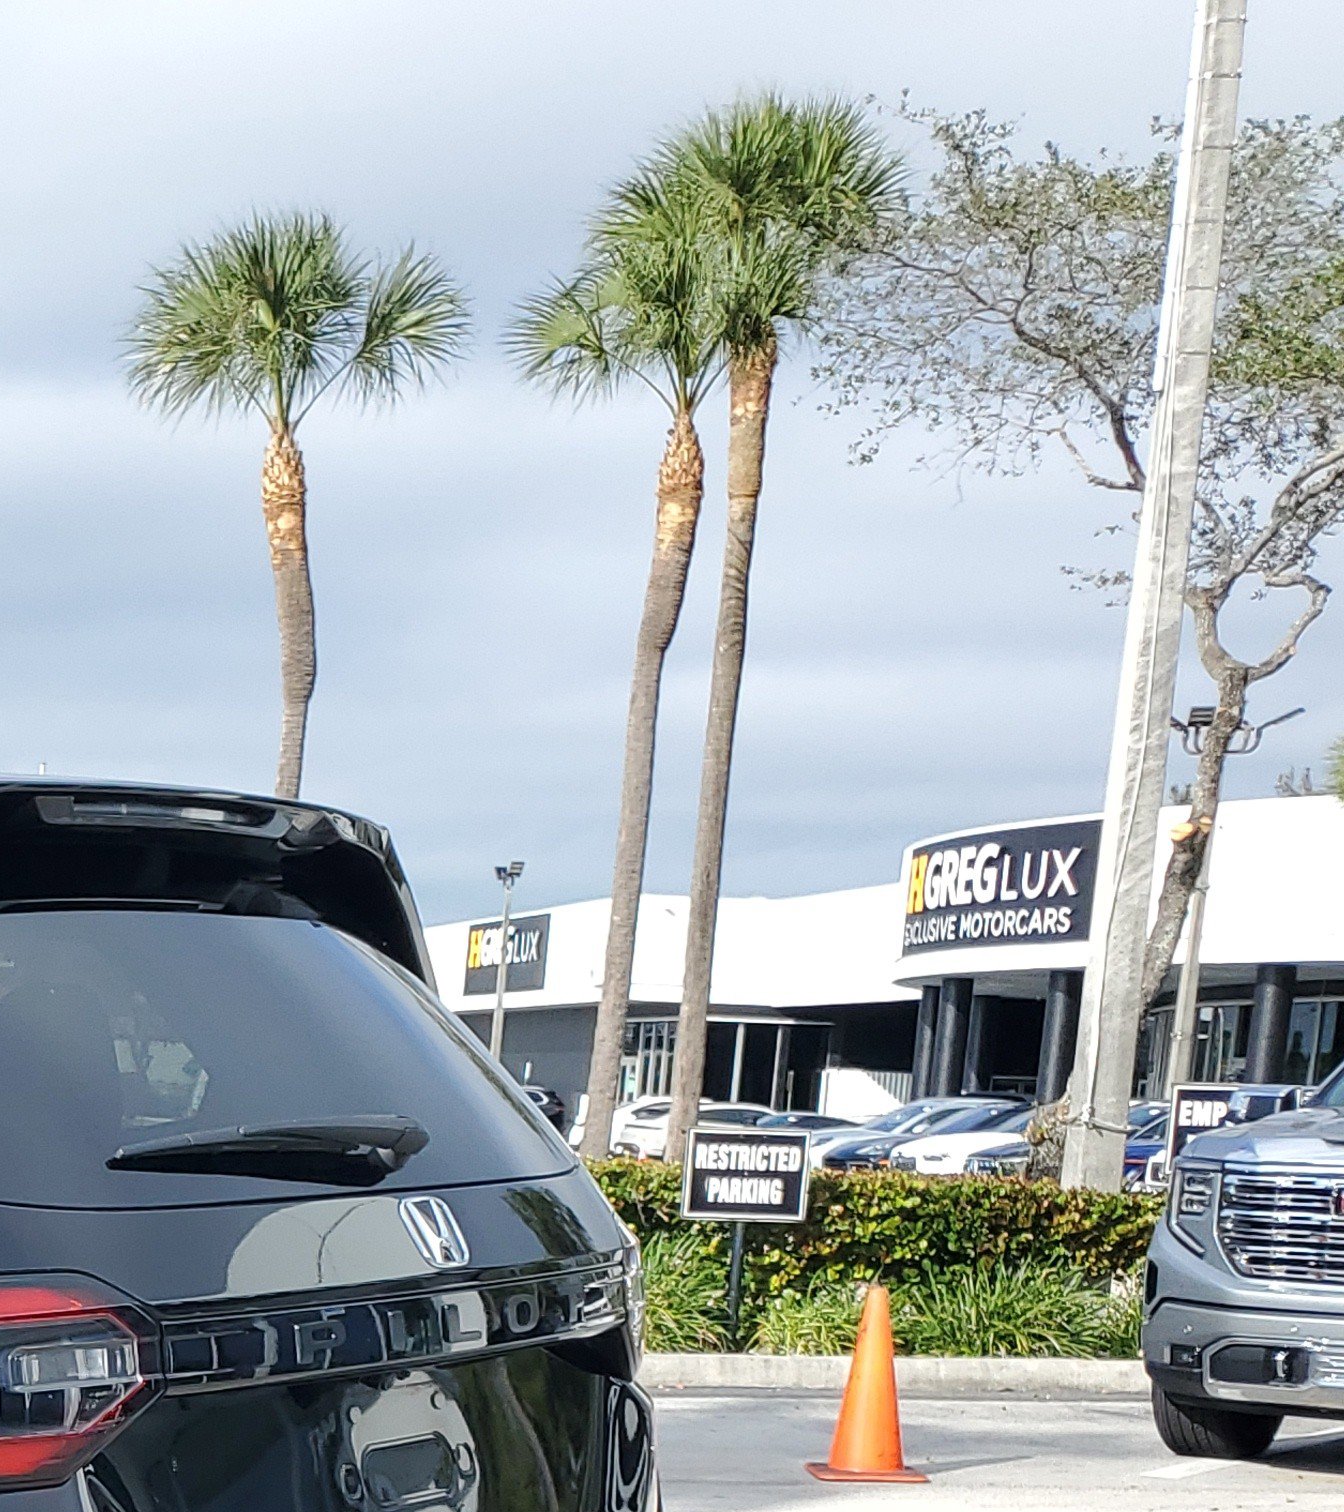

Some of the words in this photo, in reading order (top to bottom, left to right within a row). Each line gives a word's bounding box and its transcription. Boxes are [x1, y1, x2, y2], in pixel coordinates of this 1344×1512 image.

[904, 913, 958, 947] ECLUSIVE
[959, 906, 1073, 940] MOTORCARS
[1178, 1100, 1234, 1127] EMP
[694, 1142, 802, 1172] RESTRICTED
[705, 1176, 783, 1205] PARKING
[293, 1281, 586, 1365] PILOT
